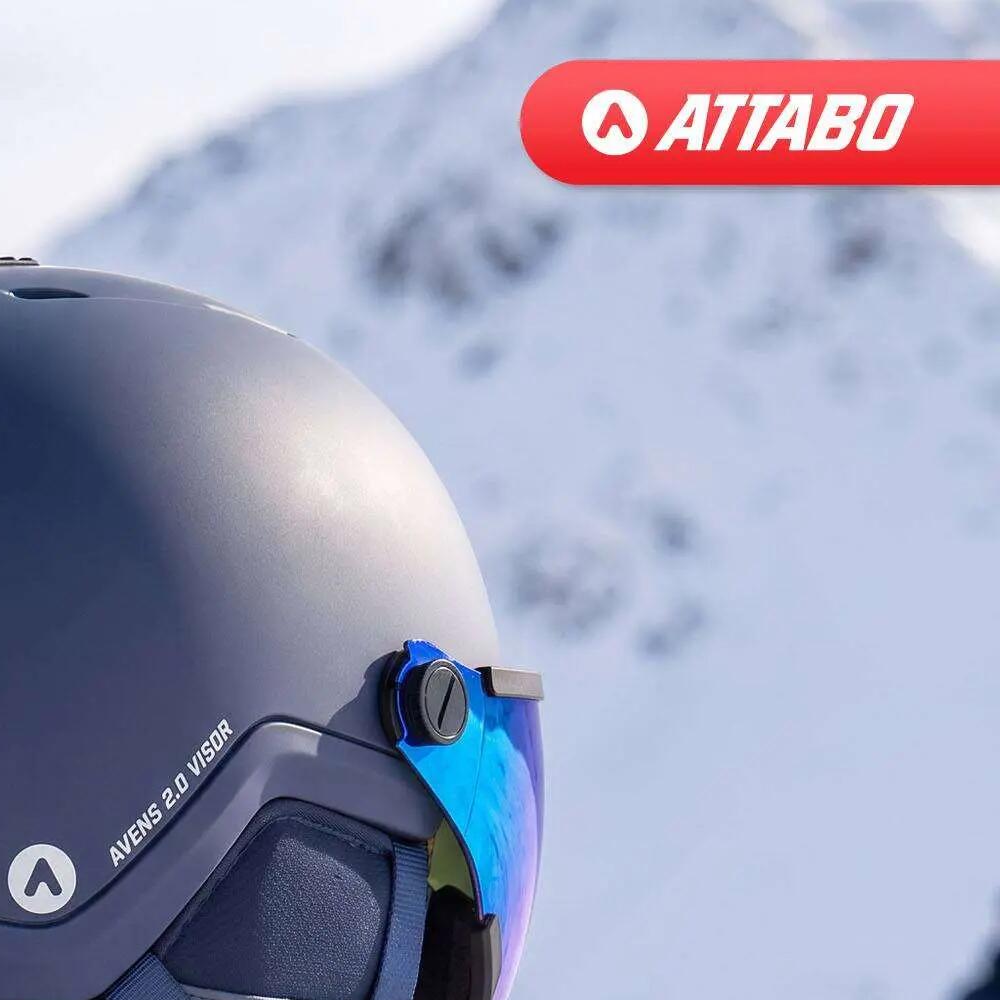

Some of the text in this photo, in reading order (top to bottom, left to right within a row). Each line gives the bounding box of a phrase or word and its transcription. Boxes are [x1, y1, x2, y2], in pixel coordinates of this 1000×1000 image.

[109, 718, 234, 867] AVENS 2.0 VISOR
